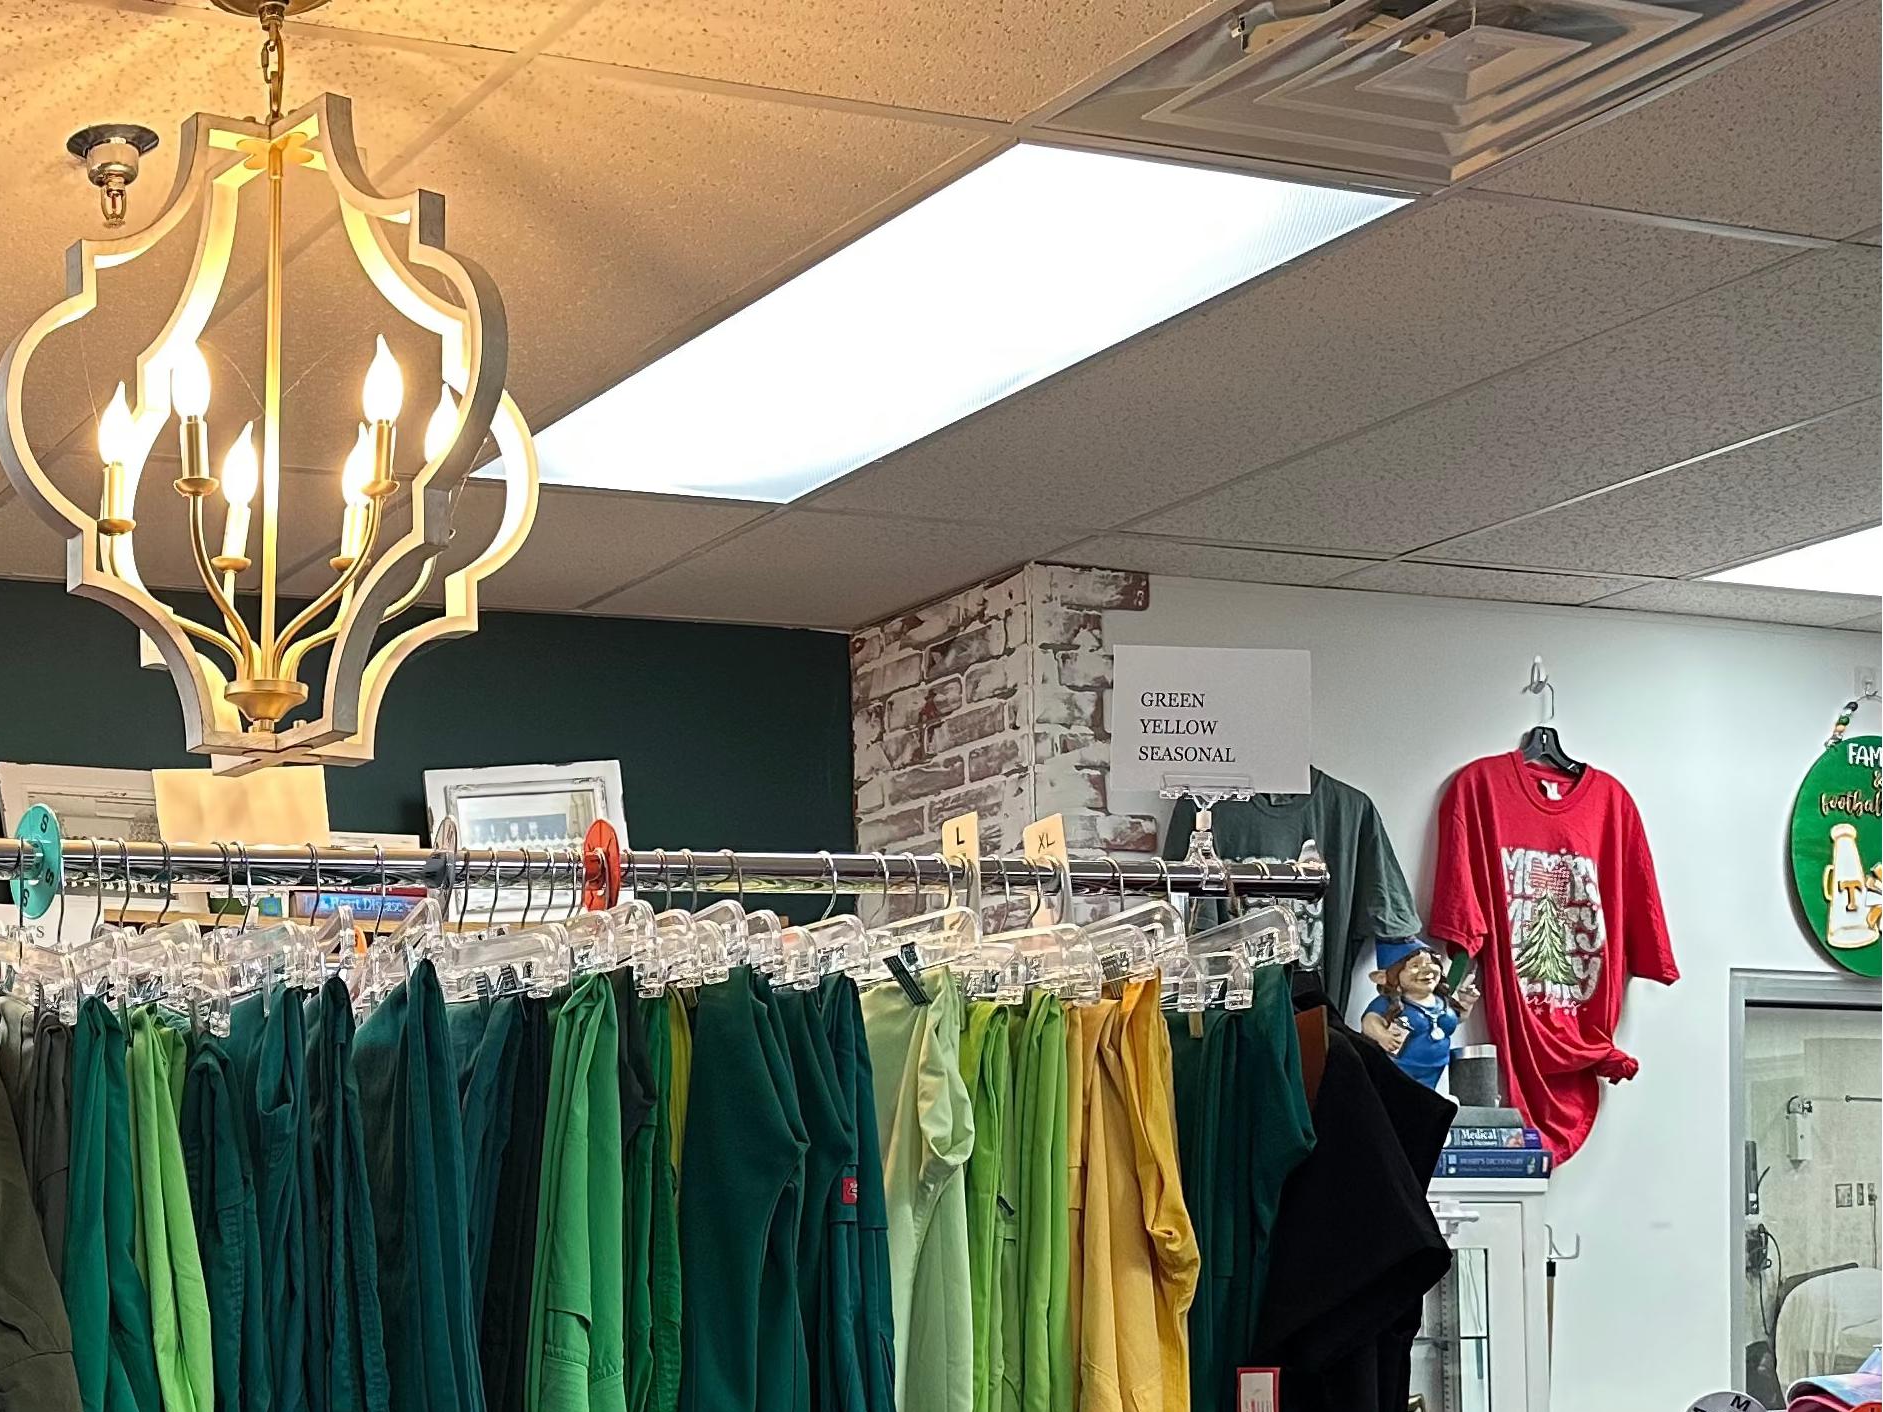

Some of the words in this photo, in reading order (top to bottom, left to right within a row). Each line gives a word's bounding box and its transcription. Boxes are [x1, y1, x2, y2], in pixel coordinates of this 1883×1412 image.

[1141, 692, 1205, 708] GREEN
[1139, 719, 1218, 735] YELLOW
[1138, 746, 1236, 763] SEASONAL
[956, 827, 965, 846] L
[1038, 832, 1055, 853] XL
[1839, 880, 1862, 911] T
[1461, 1128, 1497, 1140] Medical
[1730, 1395, 1751, 1412] M
